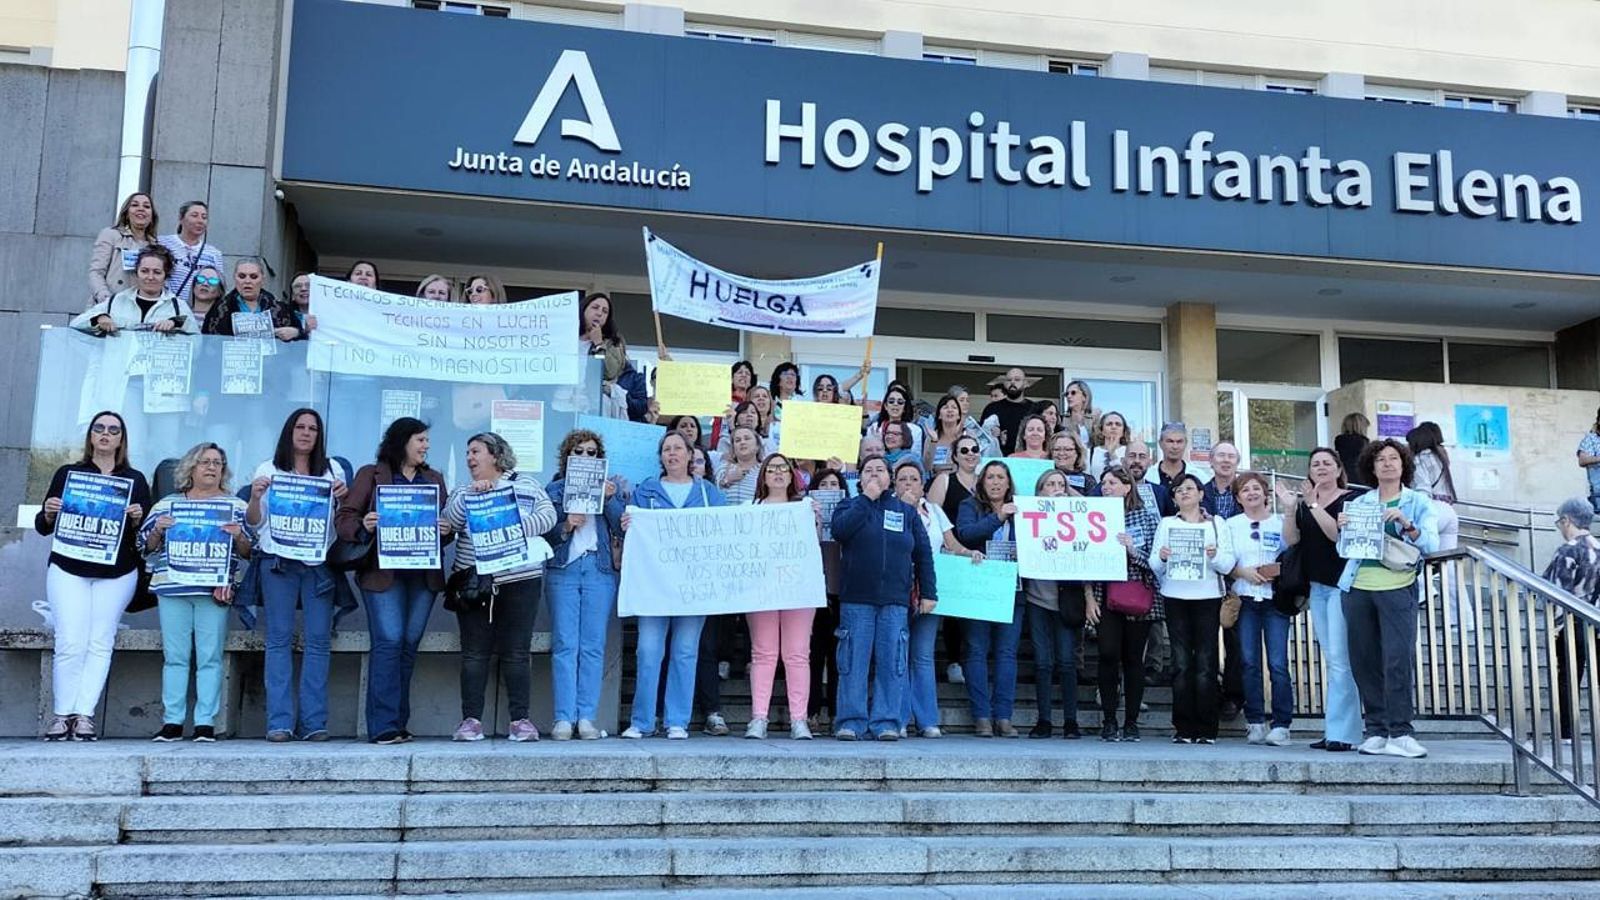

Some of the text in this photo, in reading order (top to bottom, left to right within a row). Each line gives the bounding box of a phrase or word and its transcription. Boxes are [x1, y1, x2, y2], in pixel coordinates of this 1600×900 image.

[448, 147, 691, 190] Junta de Andalucía
[764, 99, 1583, 223] Hospital Infanta Elena
[689, 269, 807, 317] HUELGA
[462, 316, 482, 329] EN
[497, 314, 549, 329] LUCHA
[417, 332, 551, 349] SIN NOSOTROS
[392, 354, 421, 369] HAY
[569, 478, 599, 486] HUELGA
[1038, 500, 1088, 513] SIN LOS
[59, 513, 120, 536] HUELGA TSS
[270, 515, 326, 534] HUELGA TSS
[506, 523, 524, 542] TSS
[656, 513, 722, 543] HACIENDA
[734, 511, 754, 535] NO
[760, 510, 797, 537] PAGA
[379, 527, 435, 542] HUELGA TSS
[1043, 537, 1057, 550] NO
[168, 540, 228, 559] HUELGA TSS
[749, 542, 761, 560] DE
[768, 540, 808, 560] SALUD
[686, 560, 801, 584] NOS IGNORAN TSS
